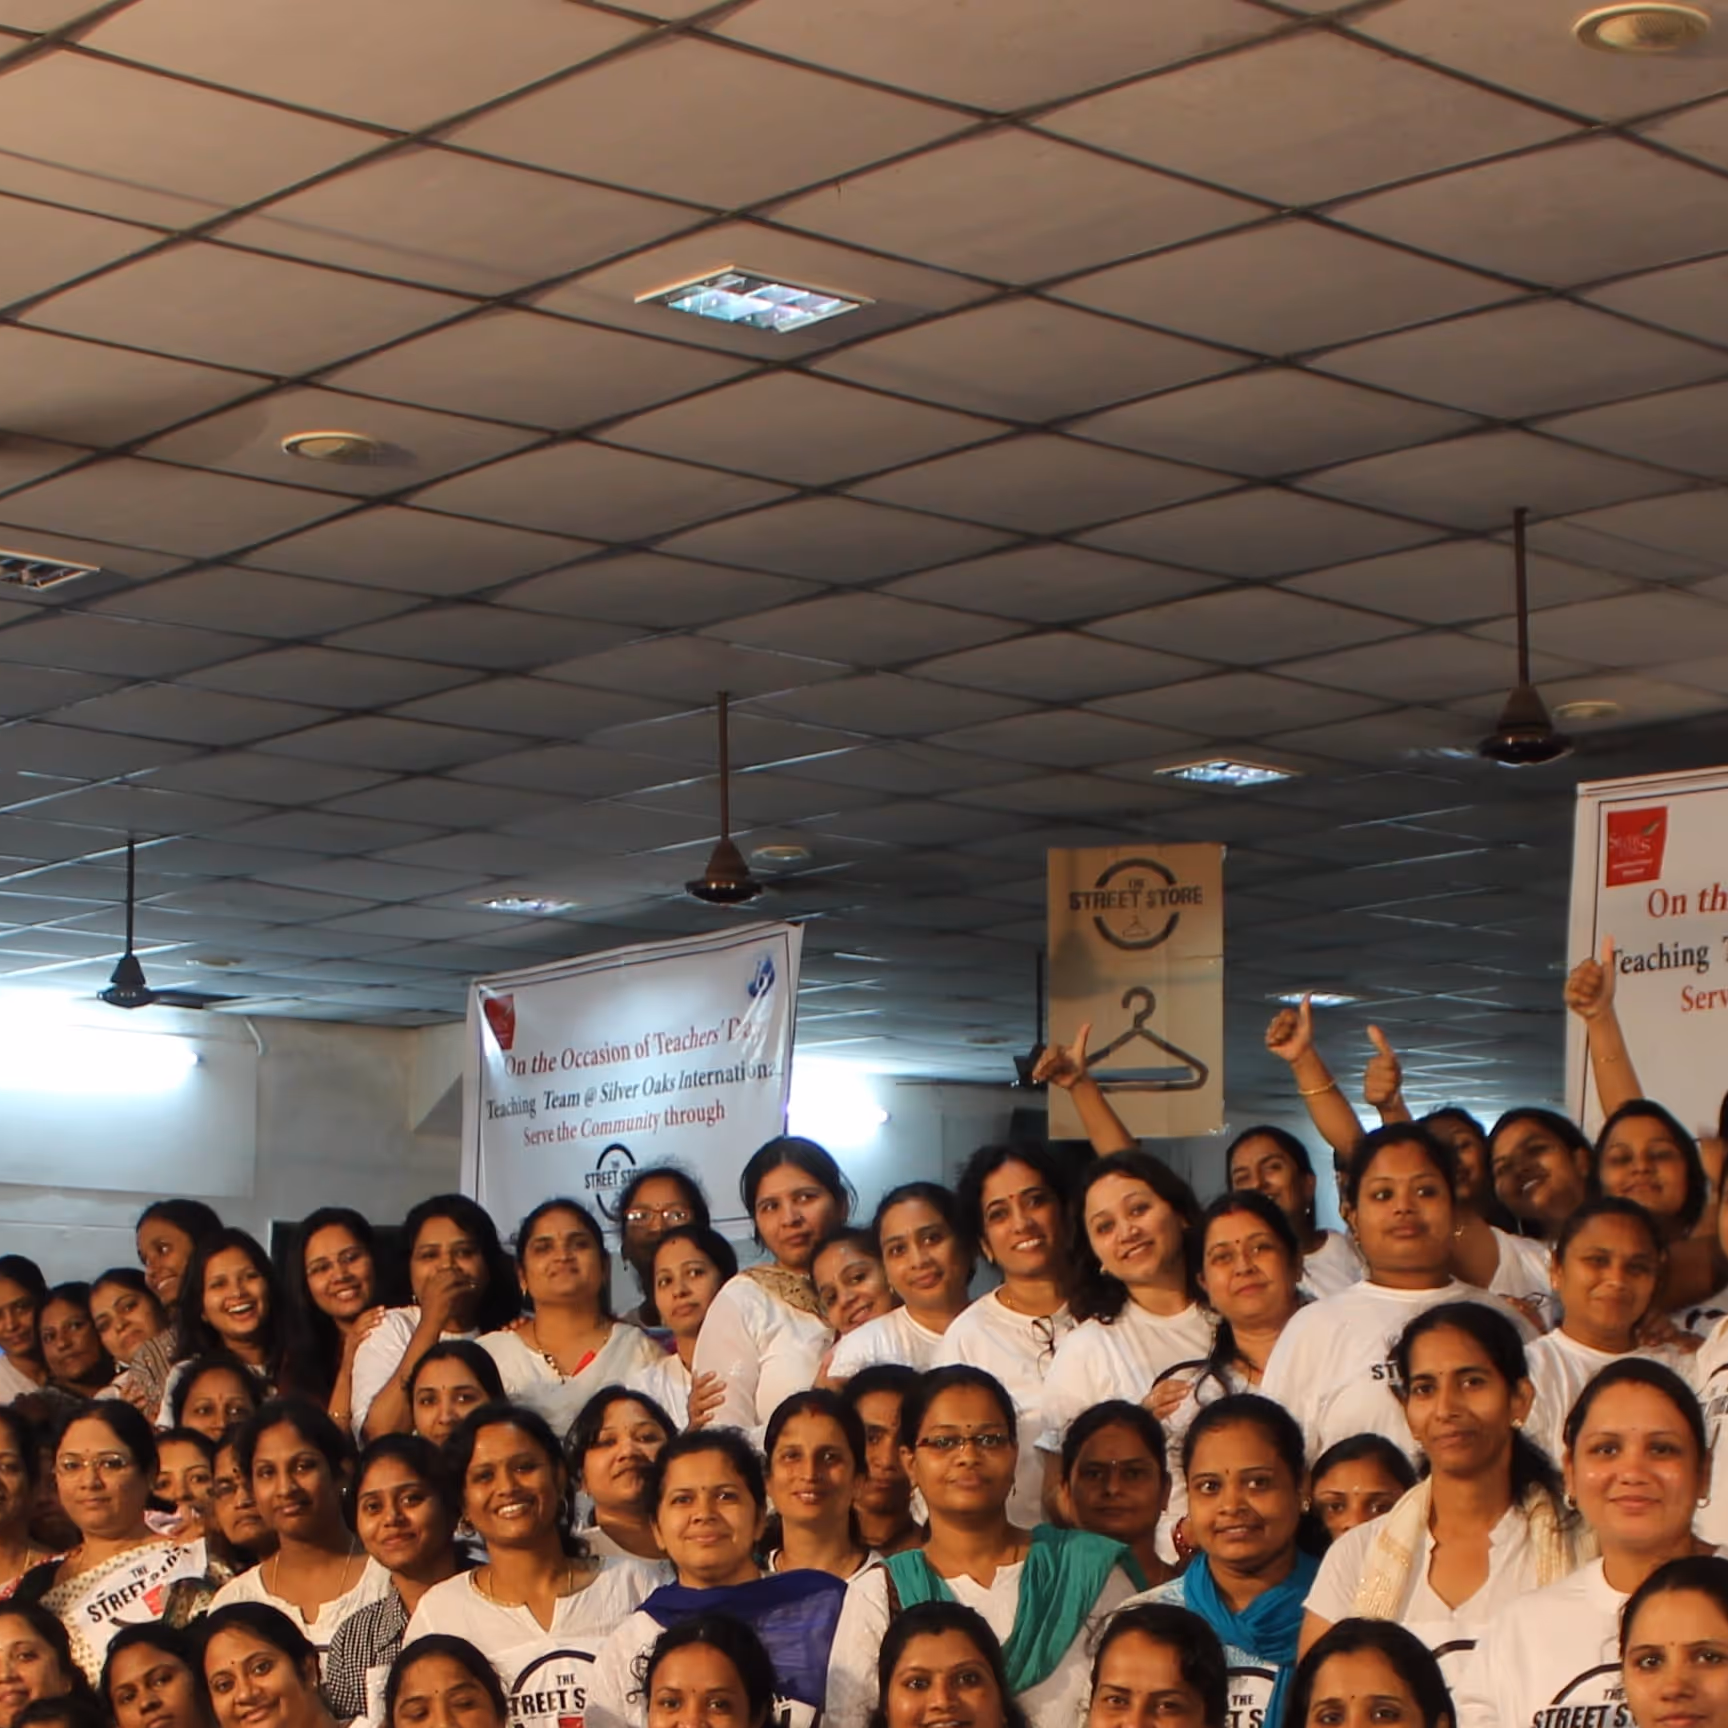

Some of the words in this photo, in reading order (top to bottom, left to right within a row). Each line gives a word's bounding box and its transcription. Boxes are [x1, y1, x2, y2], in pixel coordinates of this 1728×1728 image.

[1068, 889, 1143, 911] STREET
[1147, 886, 1204, 908] STORE
[1648, 887, 1688, 919] On
[505, 1055, 527, 1077] On
[532, 1050, 557, 1074] the
[561, 1041, 631, 1069] Occasion
[635, 1035, 652, 1059] of
[486, 1097, 537, 1121] Teaching
[543, 1088, 580, 1111] Team
[599, 1077, 640, 1104] Silver
[643, 1076, 676, 1097] Oaks
[523, 1126, 555, 1147] Serve
[557, 1121, 578, 1141] the
[580, 1108, 662, 1138] Community
[664, 1100, 726, 1131] through
[584, 1169, 618, 1190] STREET
[86, 1579, 146, 1623] STREET
[557, 1674, 576, 1685] THE
[509, 1688, 568, 1717] TREET
[1232, 1694, 1253, 1706] THE
